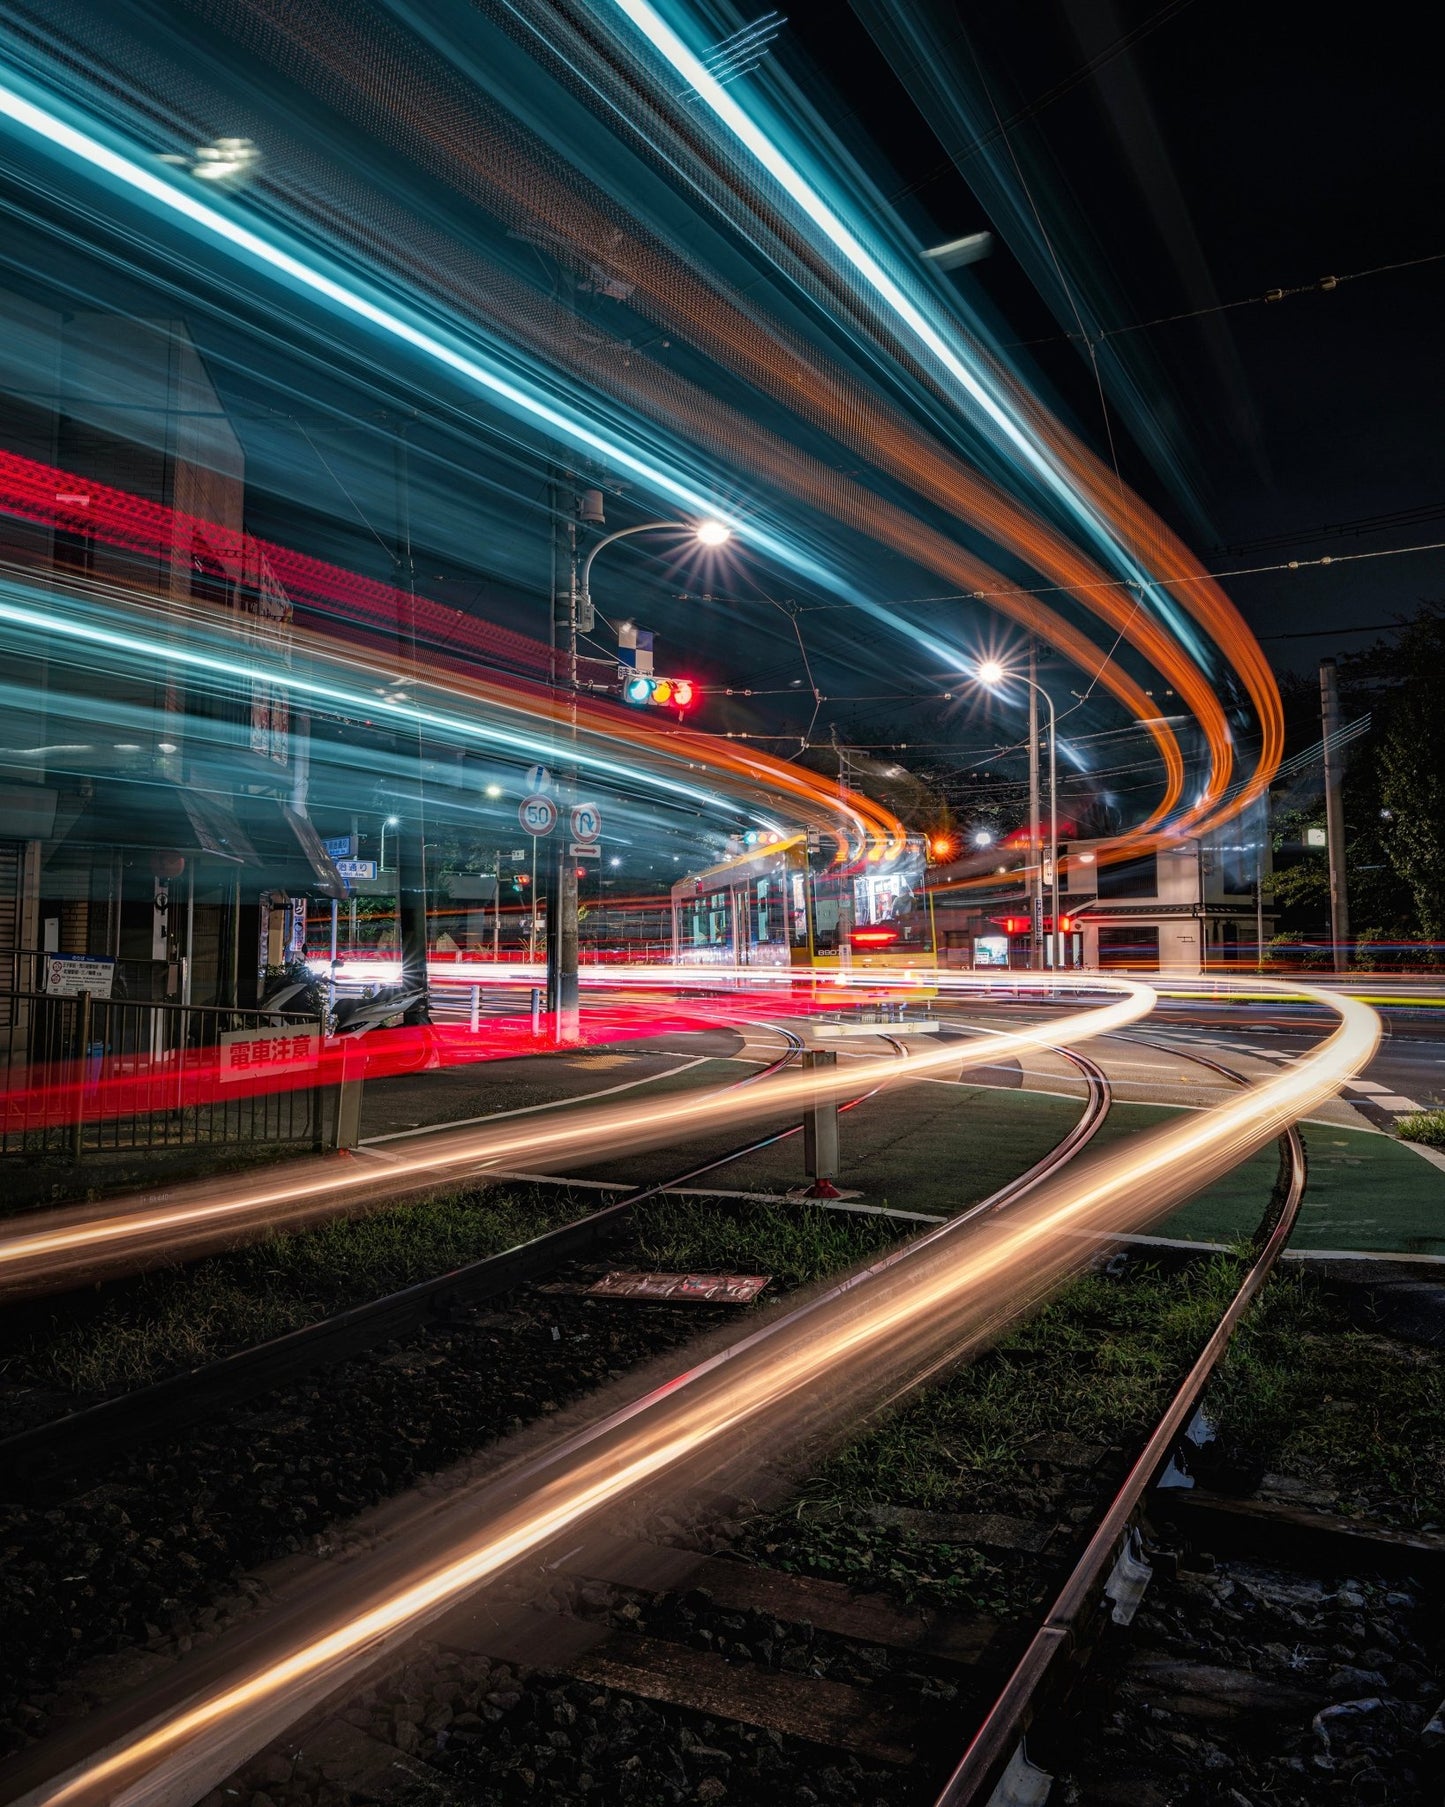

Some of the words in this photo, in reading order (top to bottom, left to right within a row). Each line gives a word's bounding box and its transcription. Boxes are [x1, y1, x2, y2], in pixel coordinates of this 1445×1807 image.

[527, 806, 549, 824] 50
[339, 863, 367, 872] 治通り
[230, 1034, 311, 1071] 電車注意
